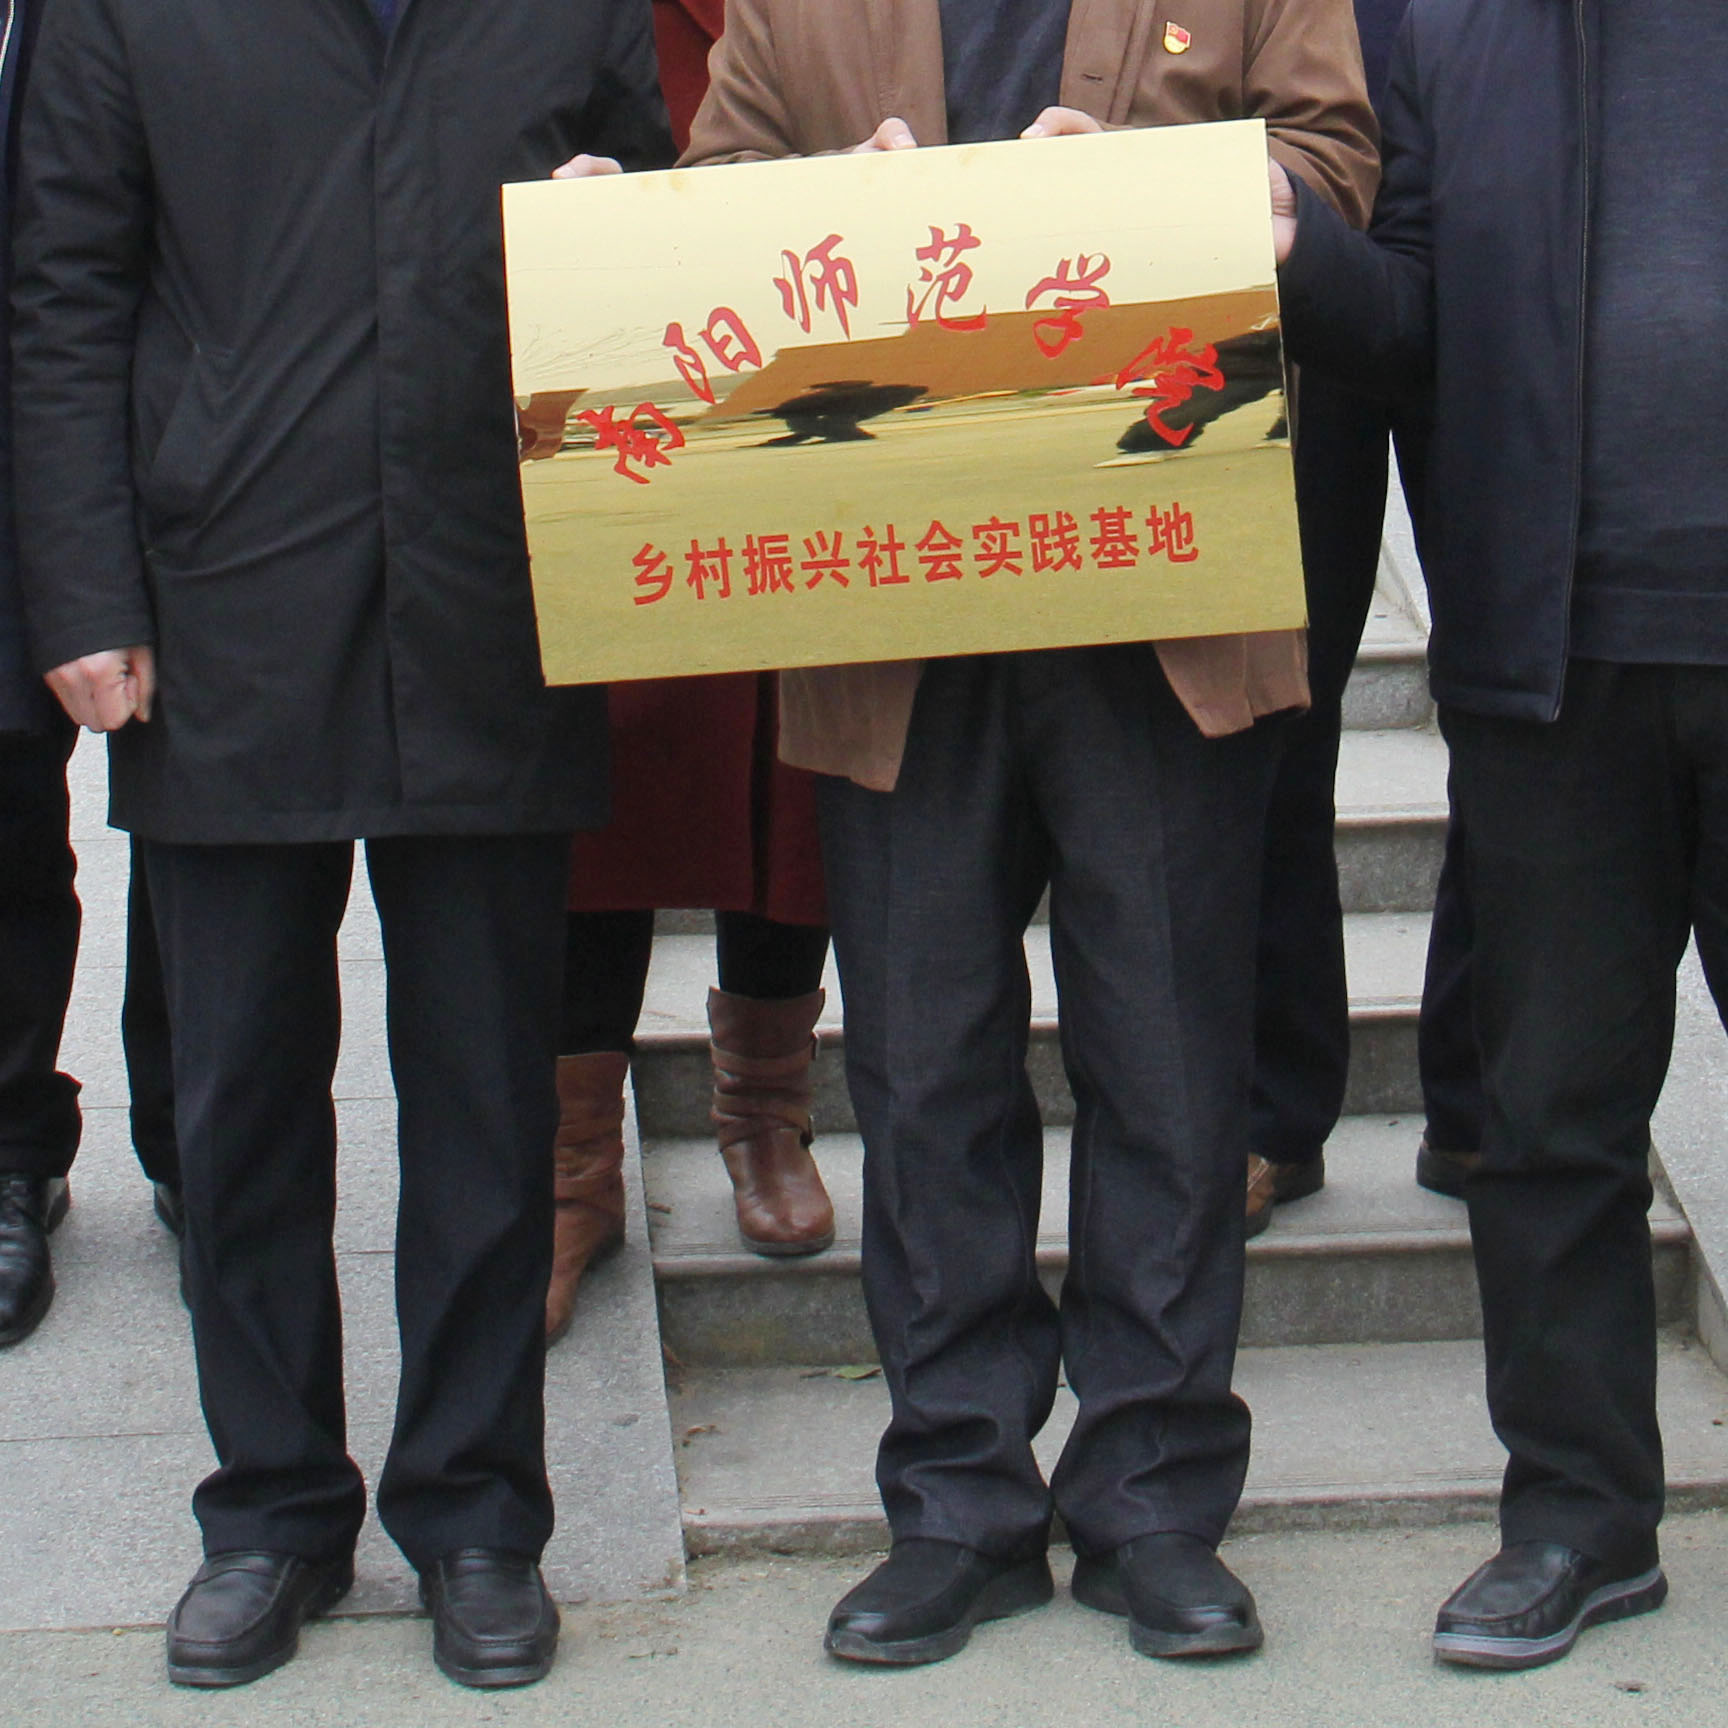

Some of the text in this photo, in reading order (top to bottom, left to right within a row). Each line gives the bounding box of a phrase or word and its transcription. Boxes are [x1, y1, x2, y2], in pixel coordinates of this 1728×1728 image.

[575, 223, 1226, 484] 南阳师范学院
[630, 502, 1201, 606] 乡村振兴社会实践基地
